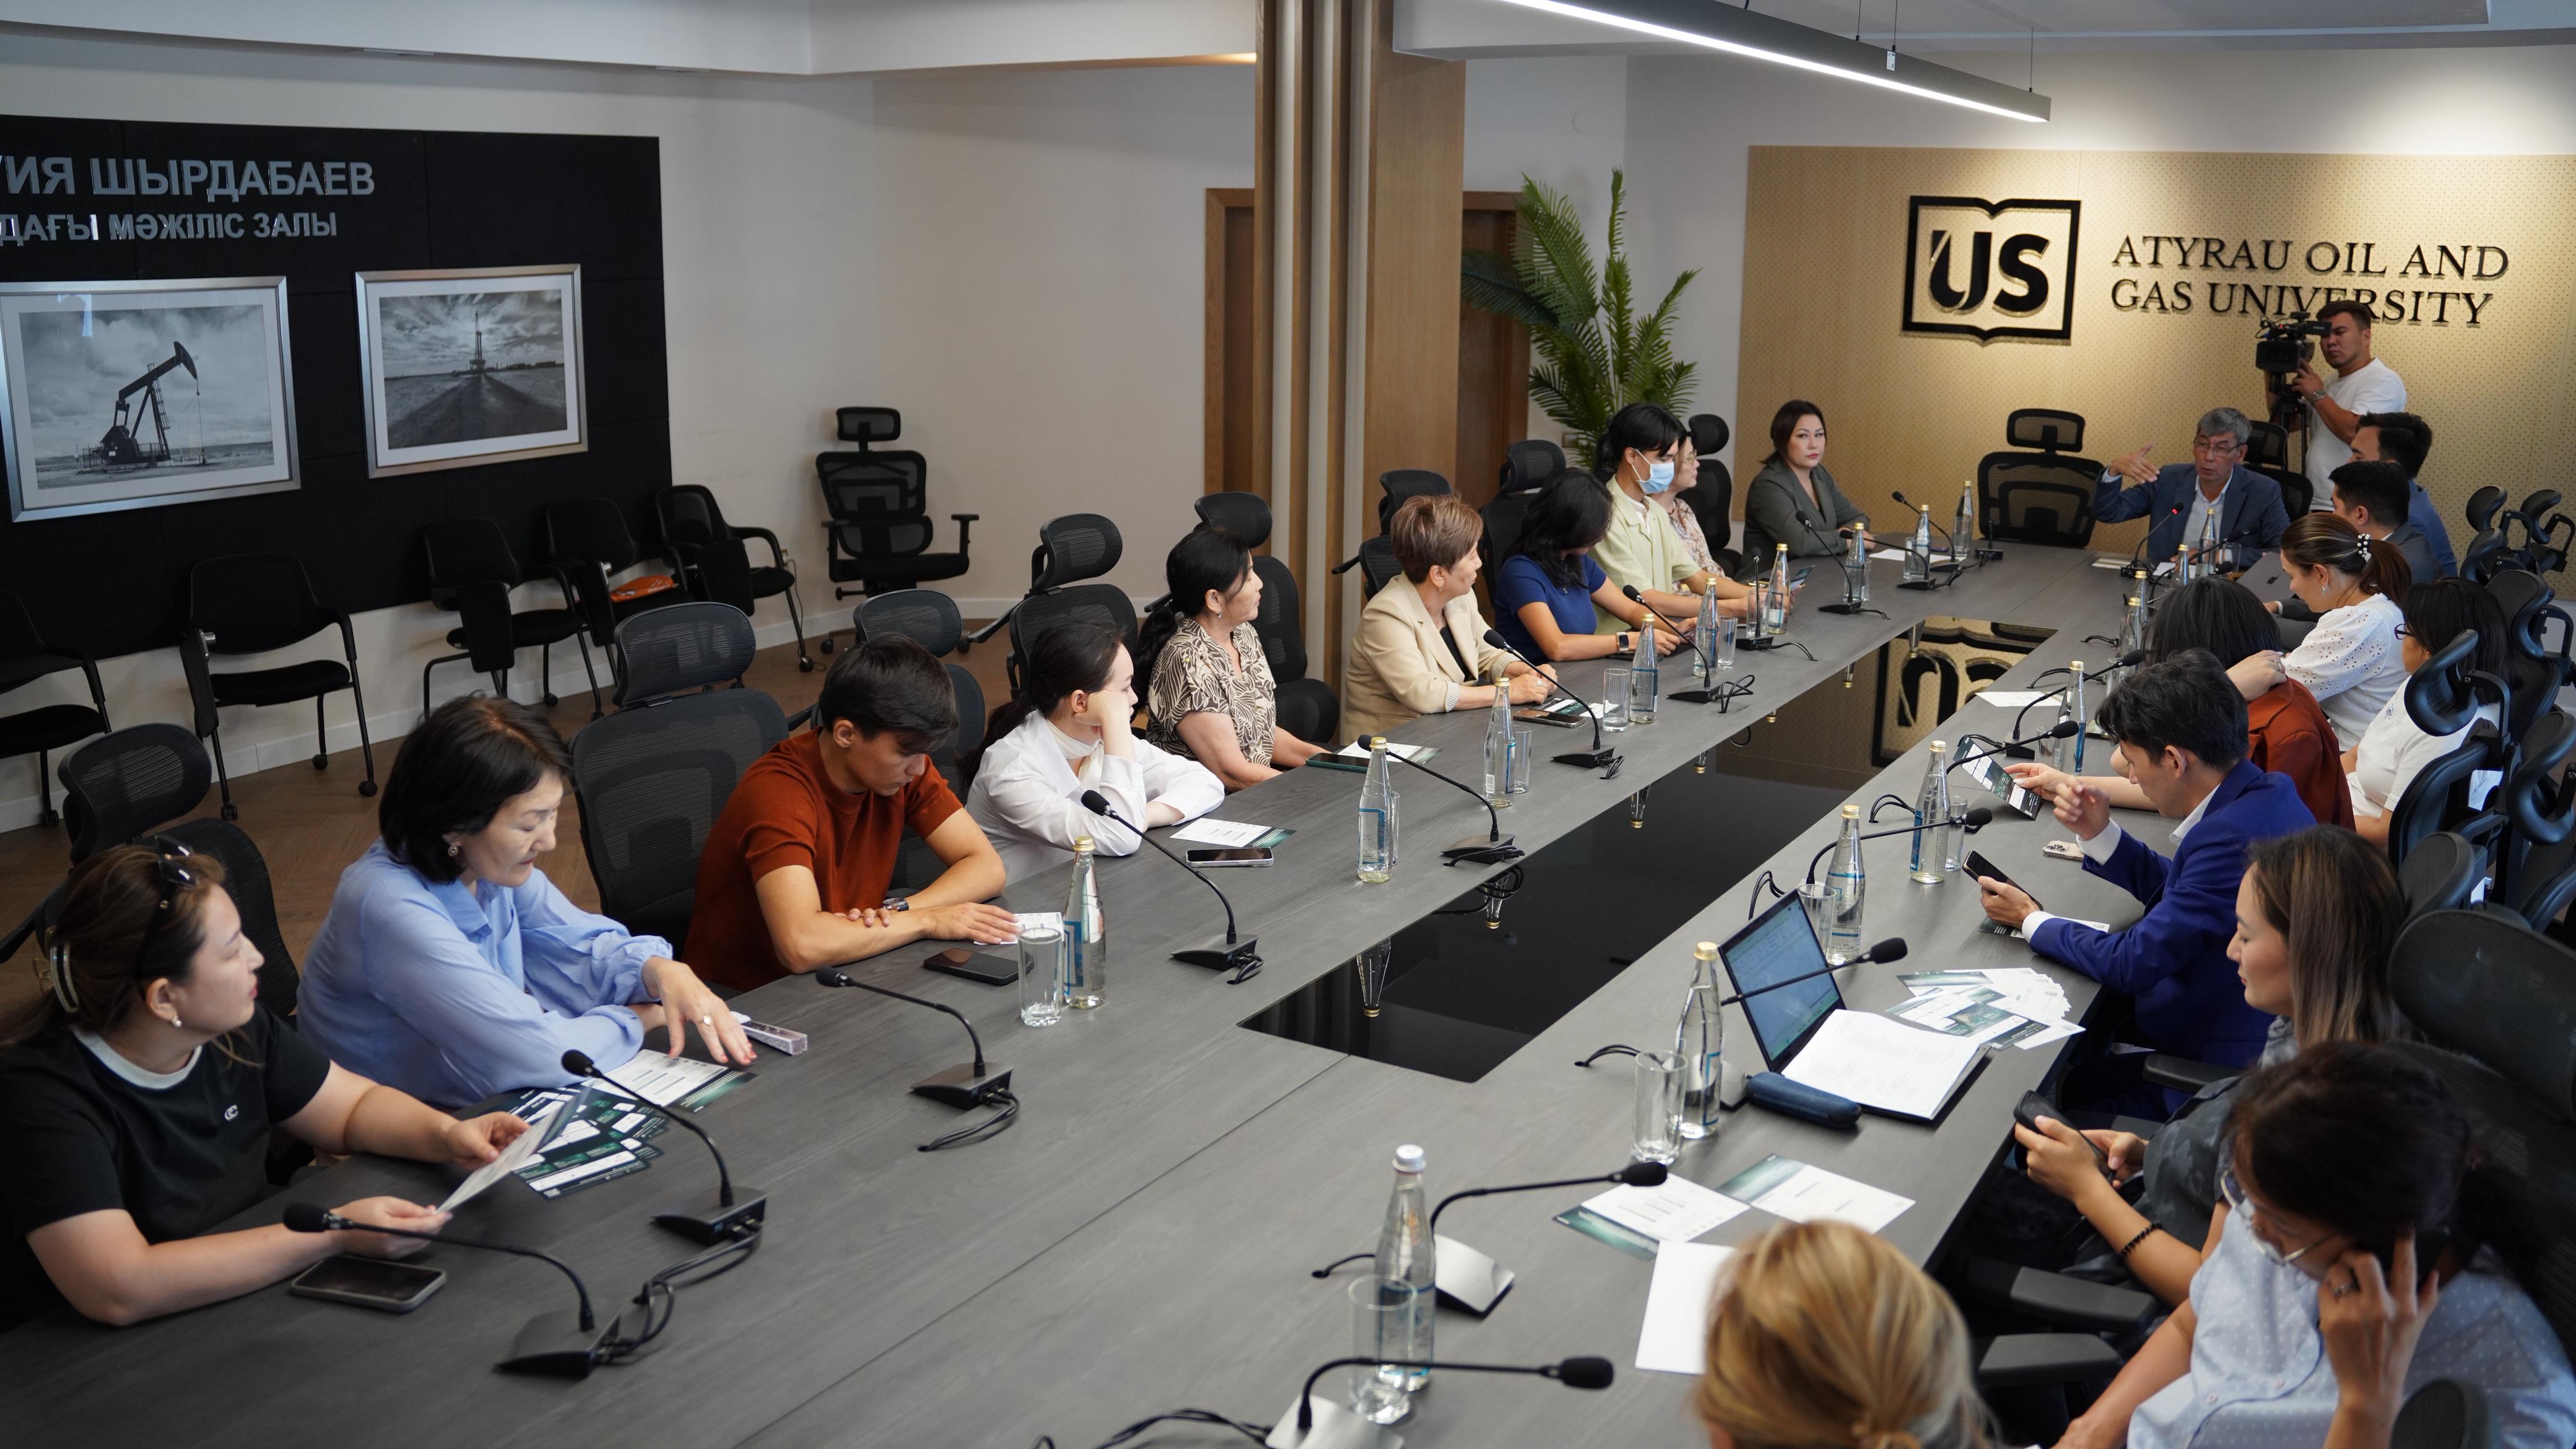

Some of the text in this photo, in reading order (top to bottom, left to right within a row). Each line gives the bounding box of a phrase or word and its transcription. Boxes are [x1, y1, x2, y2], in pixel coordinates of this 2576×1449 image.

[0, 155, 375, 202] ИЯ ШЫРДАБАЕВ
[110, 213, 245, 240] МӘЖІЛІС
[253, 212, 337, 238] ЗАЛЫ
[1930, 230, 2050, 316] US
[2112, 235, 2509, 281] ATYRAU OIL AND
[2111, 279, 2193, 314] GAS
